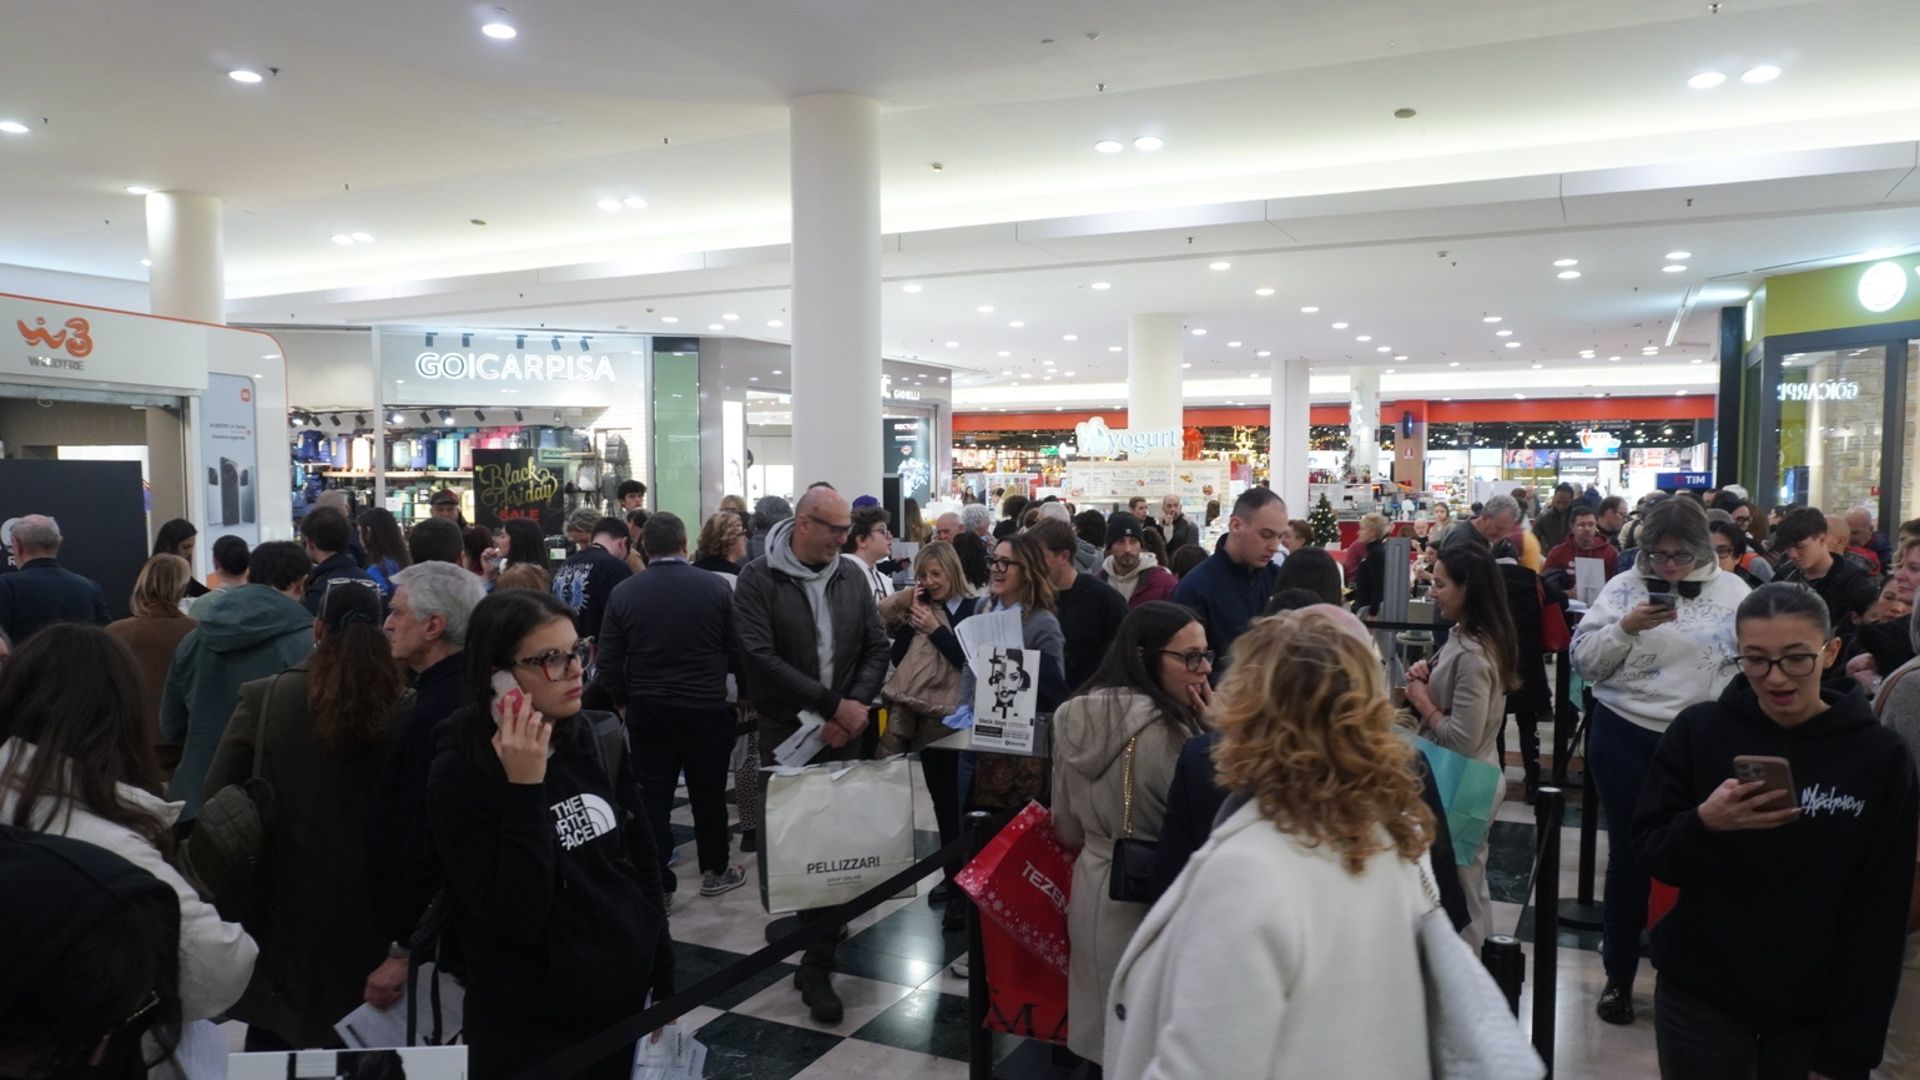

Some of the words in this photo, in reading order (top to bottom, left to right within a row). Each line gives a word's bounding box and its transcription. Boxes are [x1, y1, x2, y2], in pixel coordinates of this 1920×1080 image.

[1107, 428, 1177, 455] yogurt
[477, 455, 550, 494] Black
[1685, 474, 1706, 485] TIM
[498, 508, 541, 520] SALE
[549, 794, 584, 820] THE
[555, 809, 591, 836] RTH
[806, 855, 880, 874] PELLIZZARI
